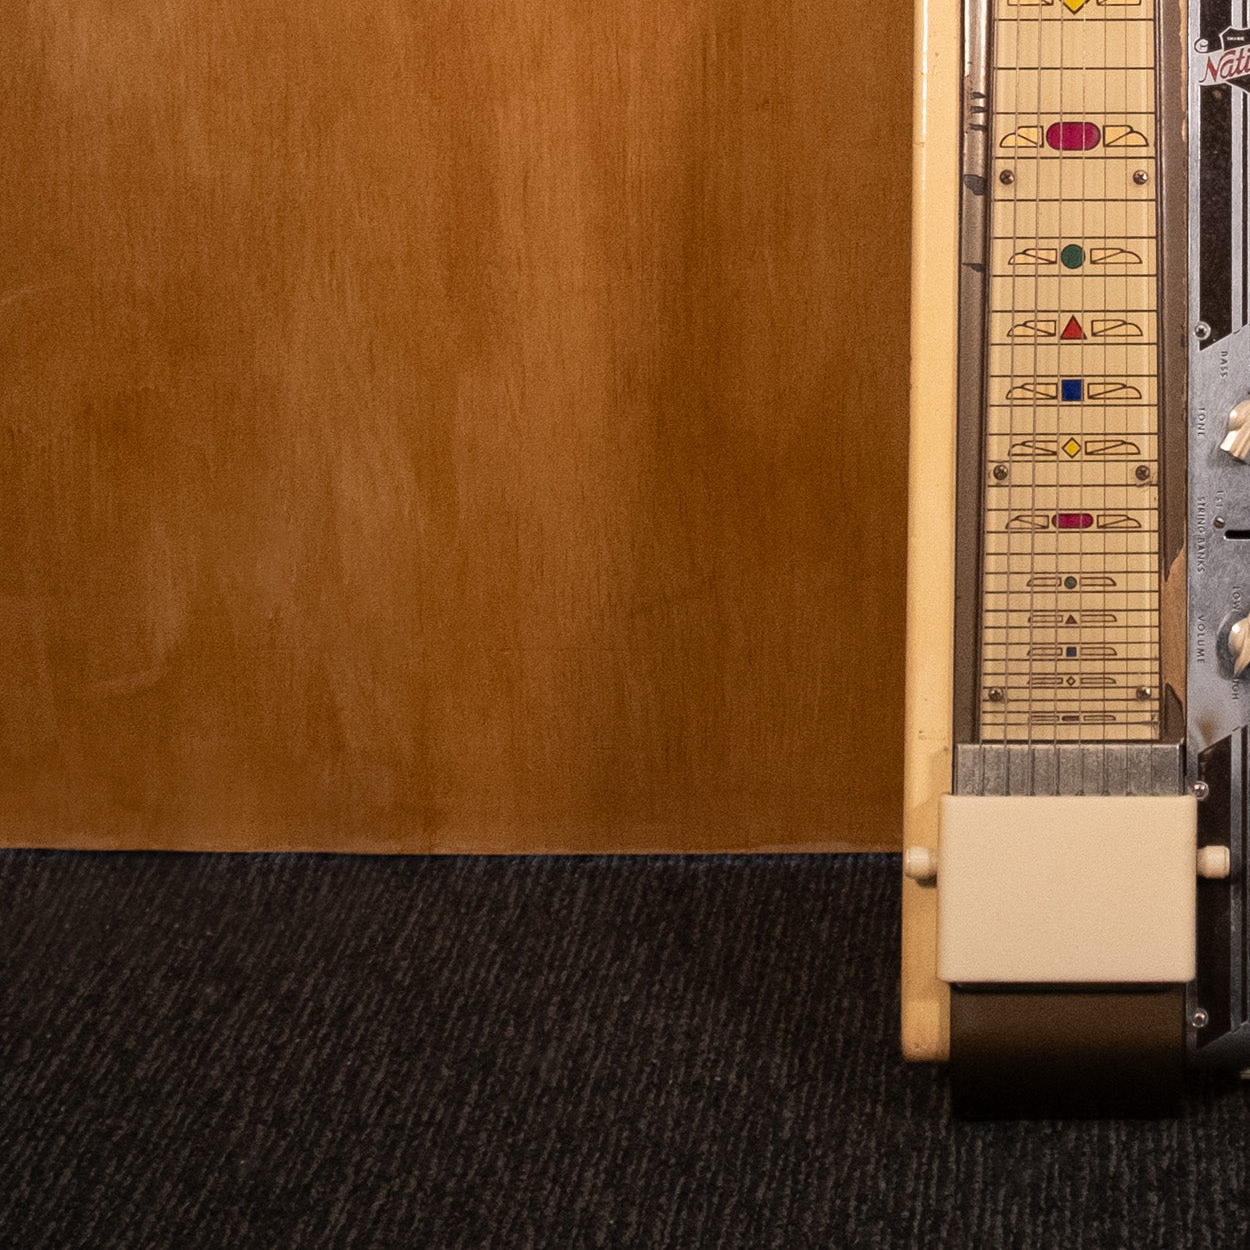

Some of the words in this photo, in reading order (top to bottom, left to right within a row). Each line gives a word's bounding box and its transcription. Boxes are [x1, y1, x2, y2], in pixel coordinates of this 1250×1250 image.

[1220, 350, 1228, 378] BASS
[1197, 496, 1206, 534] STRING
[1197, 537, 1206, 573] BANKS
[1232, 586, 1241, 611] LOW
[1197, 615, 1205, 664] VOLUME
